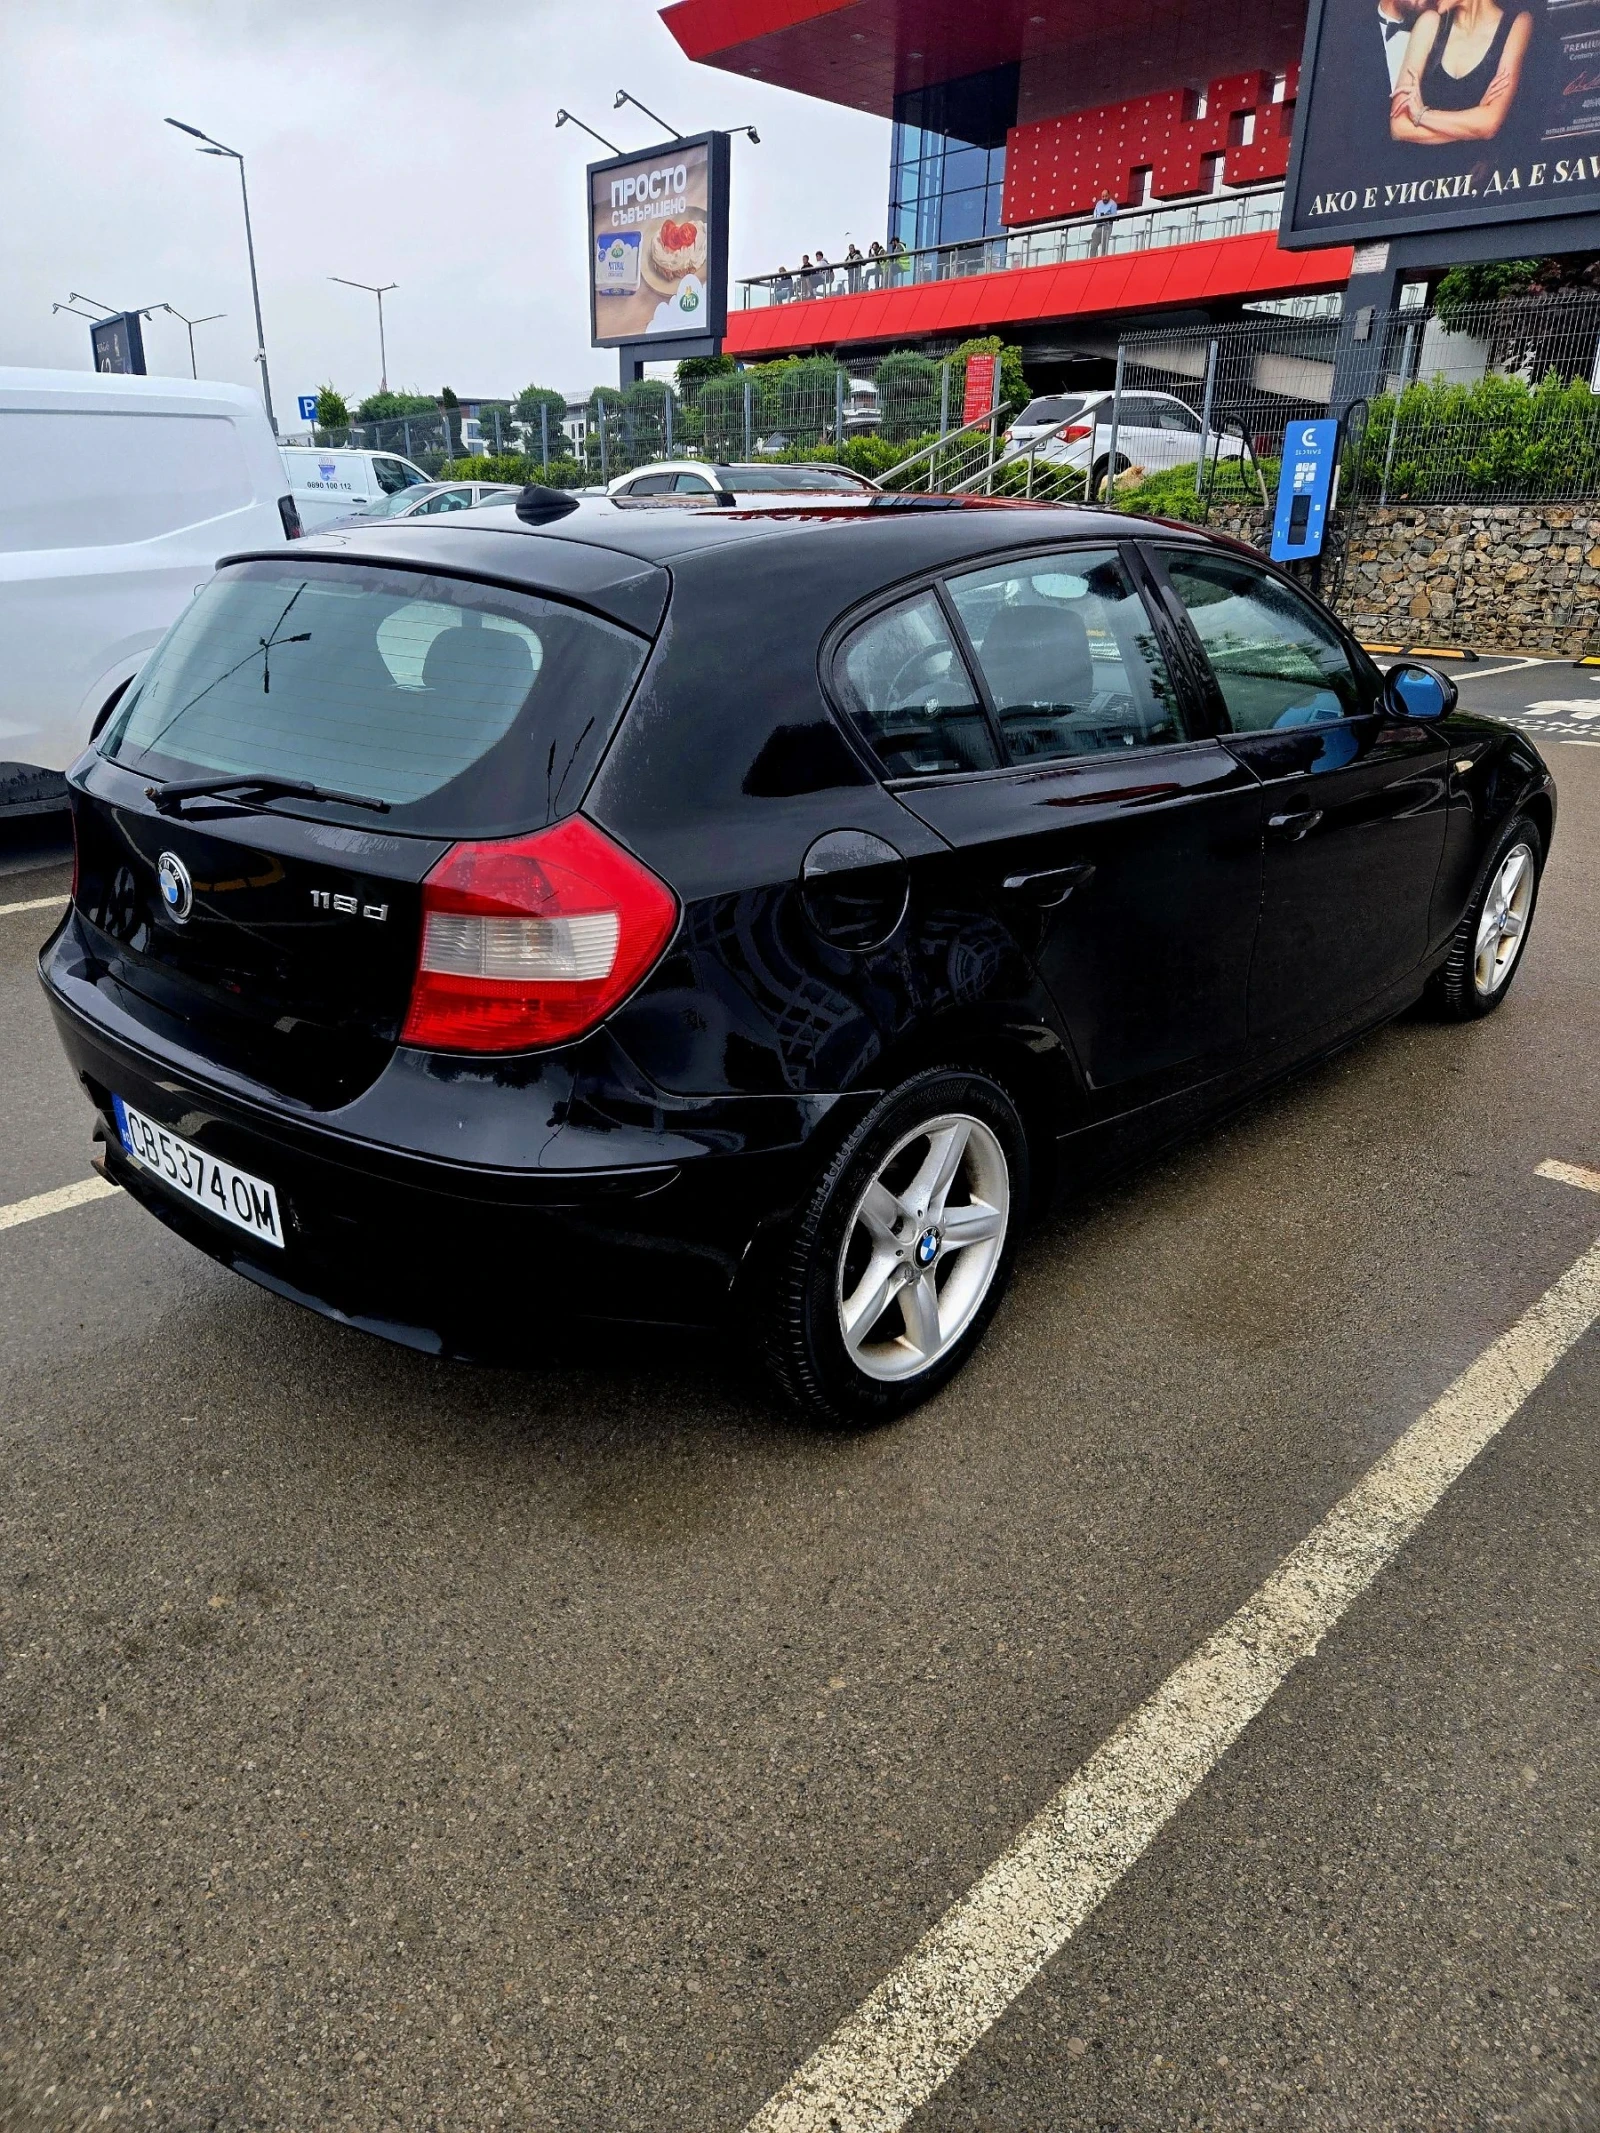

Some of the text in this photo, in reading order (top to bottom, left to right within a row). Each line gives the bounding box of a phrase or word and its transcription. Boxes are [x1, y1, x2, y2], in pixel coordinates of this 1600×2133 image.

[610, 164, 687, 208] ПРОСТО
[1308, 189, 1357, 216] АКО
[1362, 186, 1378, 209] Е
[1384, 173, 1478, 207] УИСКИ,
[1483, 167, 1521, 198] ДА
[1528, 163, 1547, 188] Е
[611, 196, 686, 227] СЪВЪРШЕНО
[303, 399, 315, 417] P
